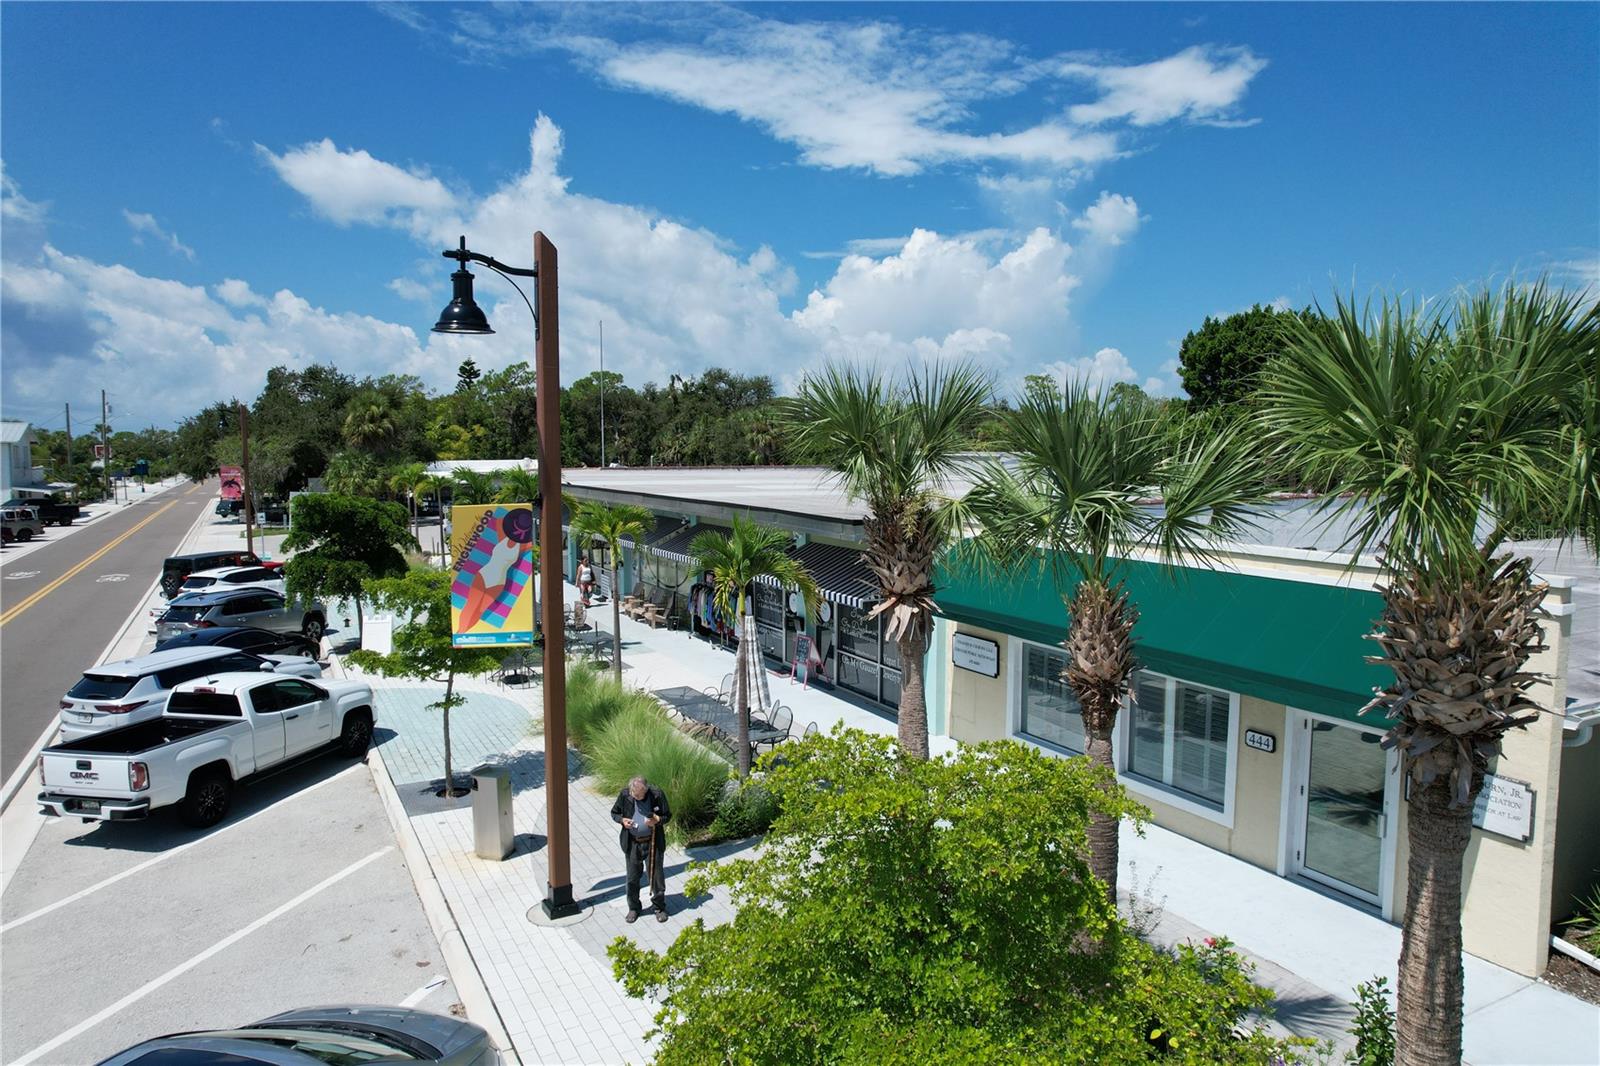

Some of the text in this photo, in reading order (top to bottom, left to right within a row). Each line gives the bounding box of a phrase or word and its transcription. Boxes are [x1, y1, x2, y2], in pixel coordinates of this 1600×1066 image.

[453, 510, 493, 571] ENGLEWOOD
[1249, 734, 1270, 749] 444
[70, 771, 99, 780] GMC
[1484, 781, 1524, 800] URN, JR.
